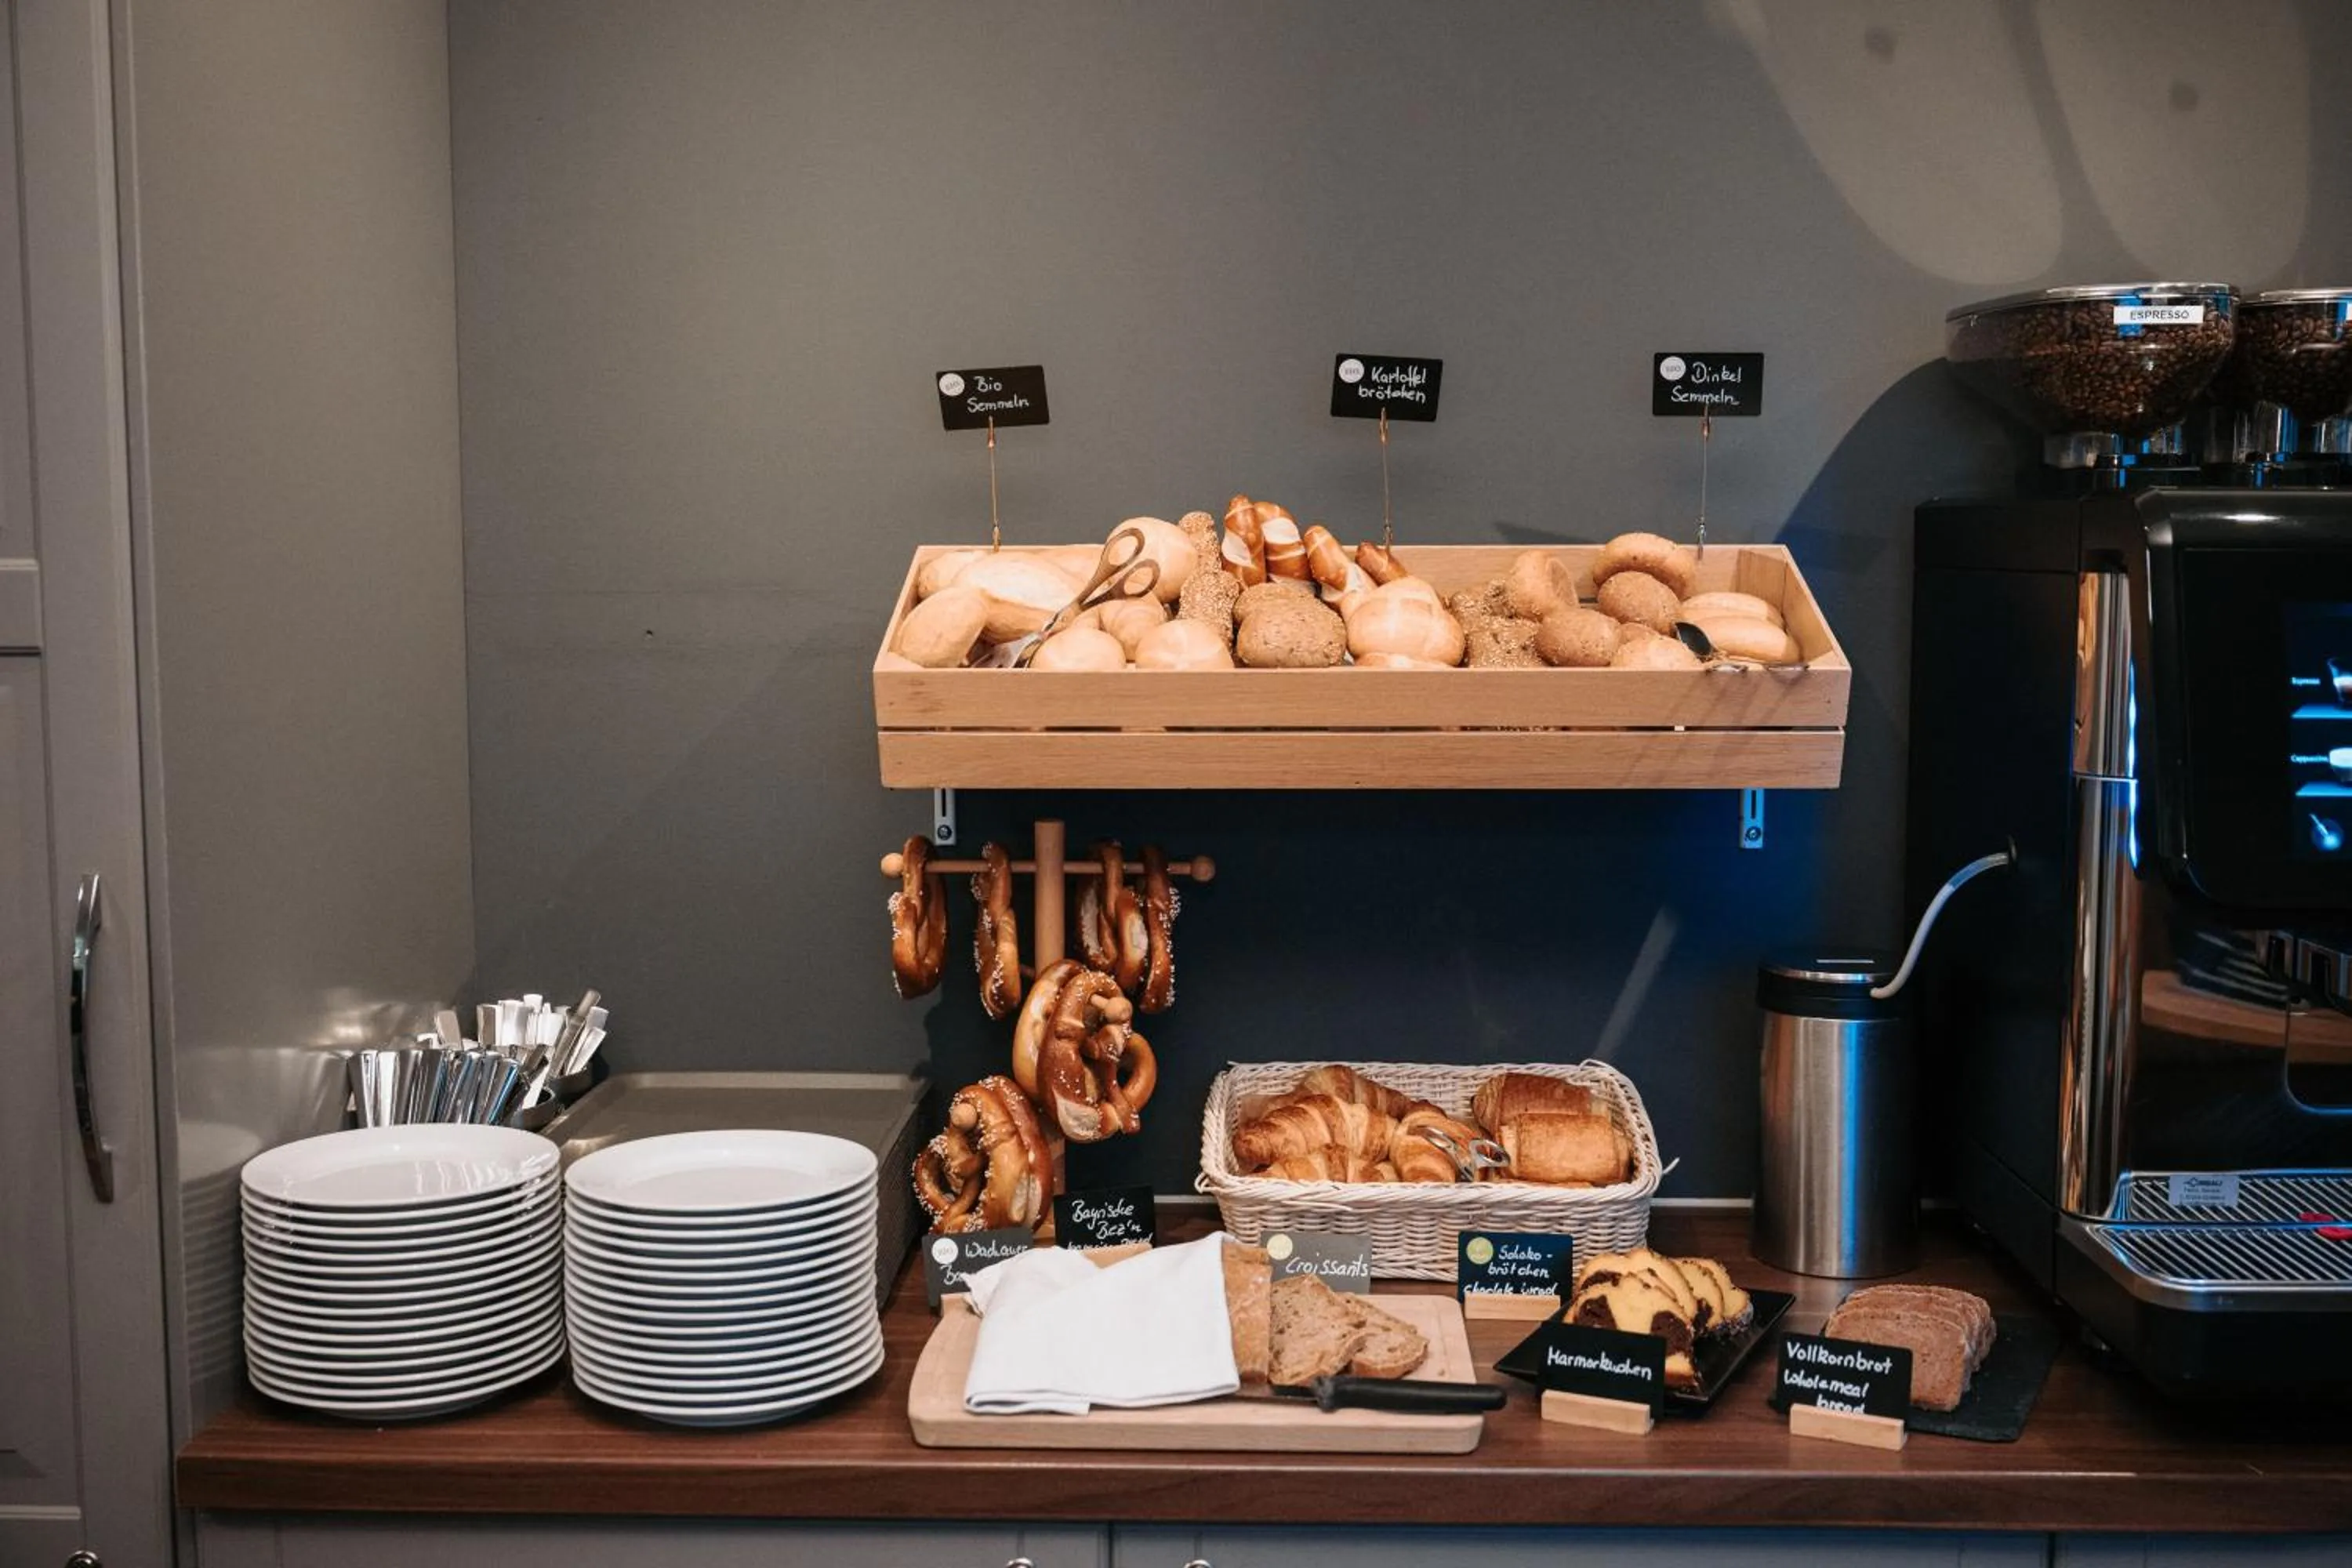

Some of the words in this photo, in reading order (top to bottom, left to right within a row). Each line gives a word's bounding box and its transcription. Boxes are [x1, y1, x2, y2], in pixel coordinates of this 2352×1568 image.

[2130, 310, 2190, 320] ESPRESSO
[1371, 365, 1427, 387] Kartoffel
[1691, 361, 1741, 383] Dinkel
[973, 376, 1003, 392] Bio
[967, 393, 1029, 413] Semmeln
[1671, 385, 1740, 405] Semmeln
[1285, 1252, 1369, 1277] Croissants
[1786, 1341, 1893, 1374] Vollkornbrot
